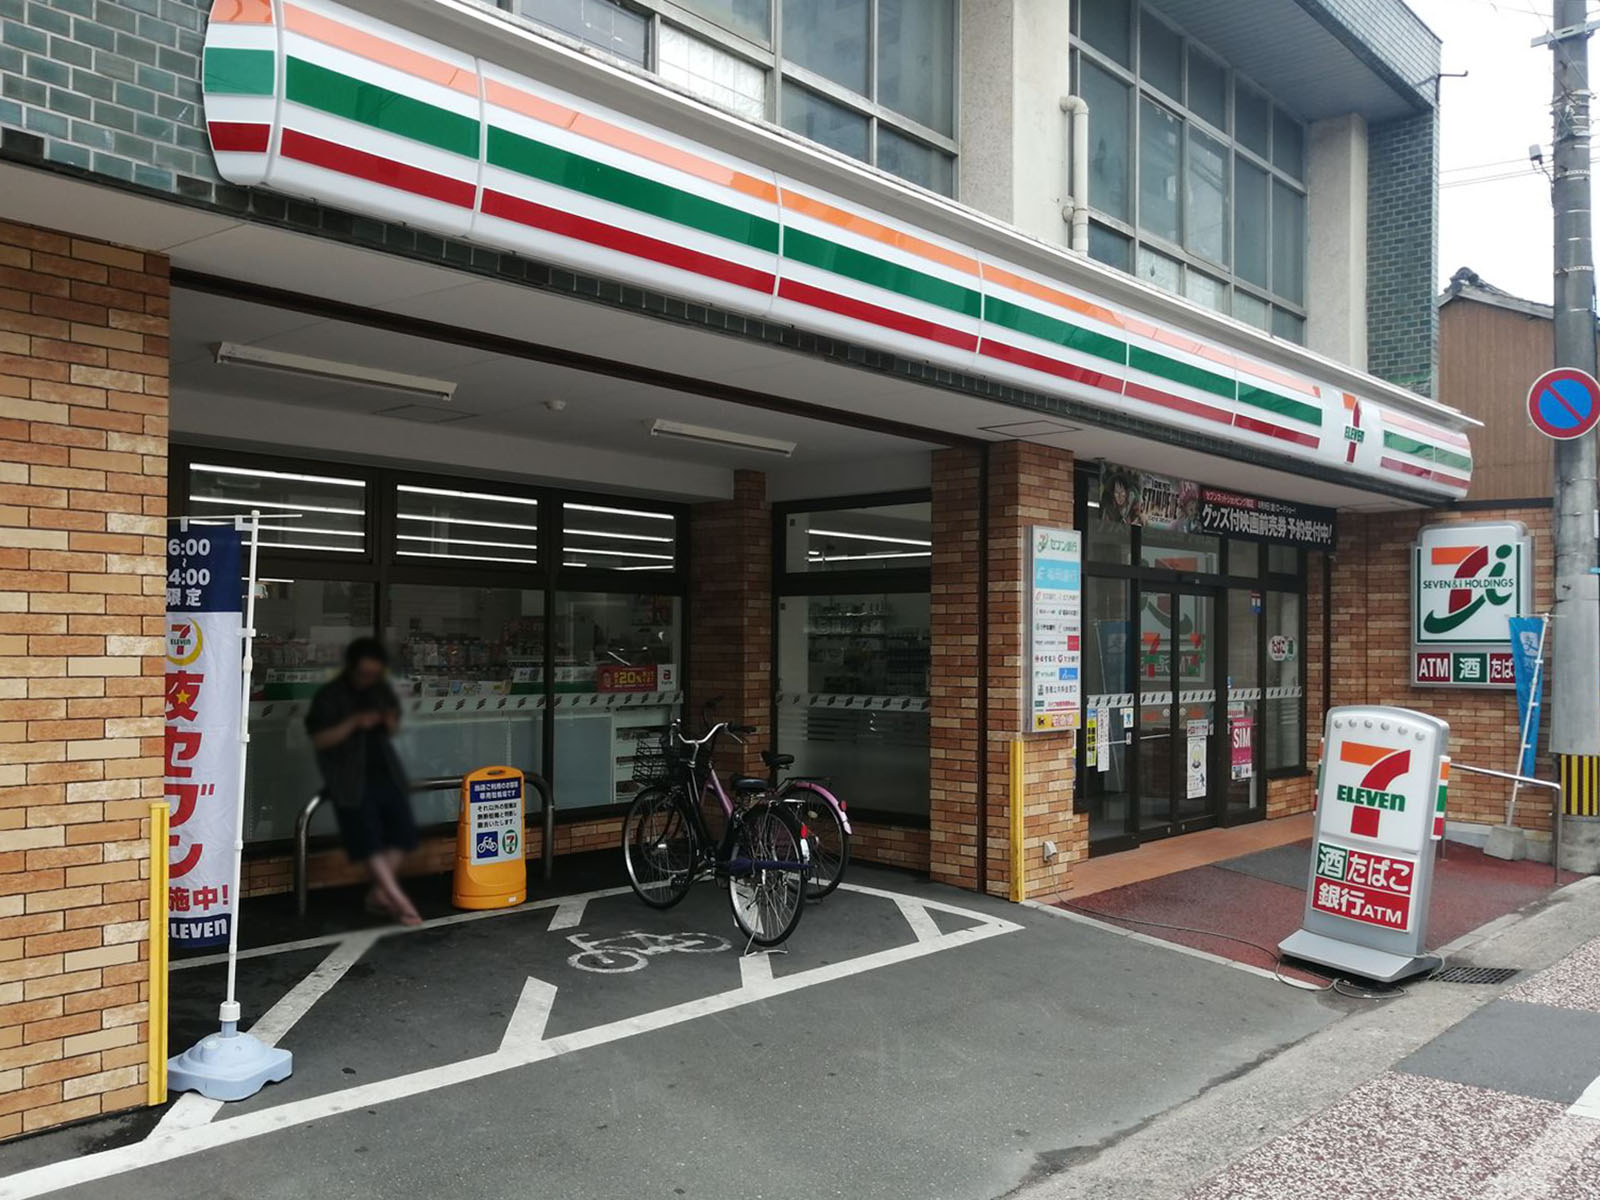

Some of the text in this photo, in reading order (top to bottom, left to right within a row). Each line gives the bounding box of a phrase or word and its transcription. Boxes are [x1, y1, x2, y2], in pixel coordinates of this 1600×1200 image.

[167, 538, 211, 556] 6:00
[1465, 578, 1514, 588] HOLDINGS
[1419, 658, 1449, 678] ATM
[1459, 657, 1481, 679] 酒
[1233, 727, 1251, 748] SIM
[1340, 741, 1411, 838] 7
[1318, 846, 1409, 892] 酒 たばこ
